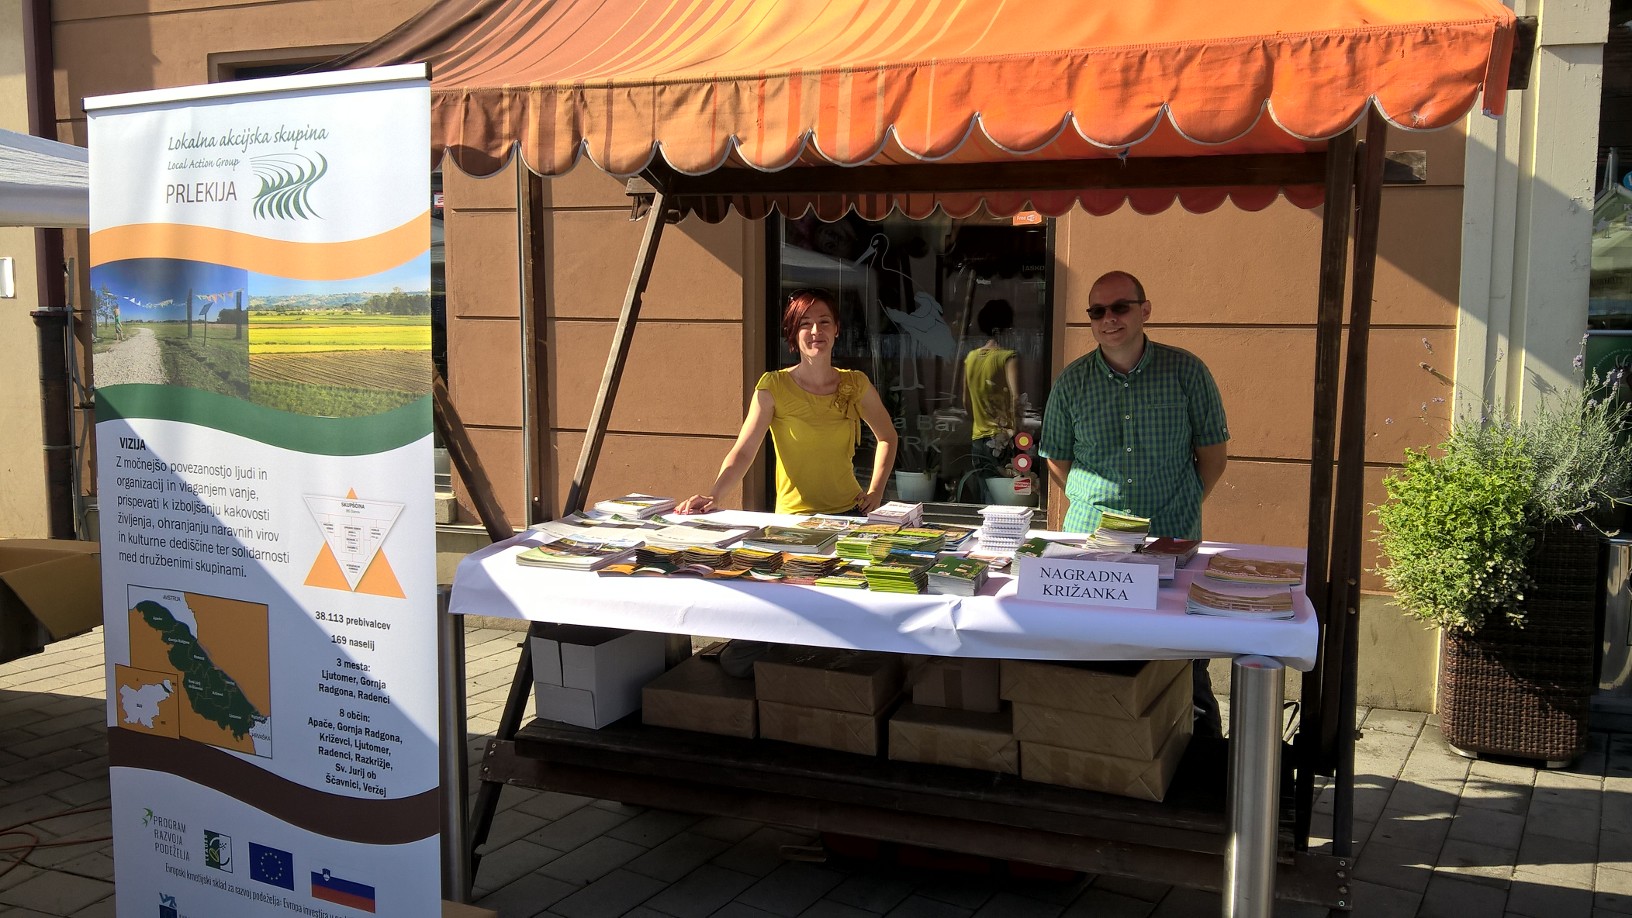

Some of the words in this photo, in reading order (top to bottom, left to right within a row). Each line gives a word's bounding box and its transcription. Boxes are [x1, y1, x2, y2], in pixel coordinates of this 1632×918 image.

[168, 131, 218, 150] Lokalna
[219, 126, 272, 153] akcijska
[273, 124, 329, 150] skupina
[168, 158, 187, 170] Local
[189, 158, 214, 169] Action
[215, 158, 240, 171] Group
[166, 181, 237, 203] PRLEKIJA
[917, 415, 956, 431] Bar
[120, 437, 146, 450] VIZIJA
[116, 456, 122, 468] Z
[124, 457, 167, 473] močnejšo
[170, 462, 232, 479] povezanostjo
[235, 465, 256, 481] ljudi
[258, 468, 267, 480] in
[116, 476, 164, 493] organizacij
[167, 479, 176, 492] in
[179, 481, 227, 497] vlaganjem
[229, 487, 259, 501] vanje,
[117, 495, 159, 509] prispevati
[163, 499, 169, 509] k
[172, 500, 221, 516] izboljšanju
[224, 505, 270, 521] kakovosti
[118, 512, 155, 529] življenja,
[157, 518, 209, 535] ohranjanju
[211, 524, 253, 539] naravnih
[256, 529, 279, 542] virov
[119, 531, 126, 543] in
[128, 533, 166, 548] kulturne
[169, 536, 213, 553] dediščine
[217, 543, 229, 555] ter
[232, 545, 290, 563] solidarnosti
[119, 551, 137, 562] med
[140, 553, 193, 570] družbenimi
[195, 559, 247, 577] skupinami.
[1040, 566, 1134, 584] NAGRADNA
[1042, 584, 1128, 600] KRIŽANKA
[315, 611, 344, 623] 38.113
[346, 617, 391, 630] prebivalcev
[331, 634, 347, 645] 169
[349, 638, 375, 651] naselij
[337, 658, 342, 667] 3
[344, 660, 370, 672] mesta:
[322, 670, 359, 686] Ljutomer,
[360, 676, 386, 690] Gornja
[319, 683, 356, 699] Radgona,
[358, 690, 390, 704] Radenci
[339, 709, 344, 717] 8
[346, 709, 370, 722] občin:
[308, 716, 335, 730] Apače,
[337, 722, 363, 735] Gornja
[364, 727, 403, 744] Radgona,
[319, 732, 353, 748] Križevci,
[354, 739, 391, 756] Ljutomer,
[318, 746, 353, 762] Radenci,
[355, 754, 393, 771] Razkrižje,
[335, 763, 347, 773] Sv.
[348, 765, 365, 779] Jurij
[367, 770, 376, 780] ob
[325, 773, 362, 791] Ščavnici,
[363, 782, 386, 797] Veržej
[153, 816, 186, 833] PROGRAM
[154, 829, 183, 846] RAZVOJA
[155, 842, 190, 862] PODEŽELJA
[228, 884, 234, 892] za
